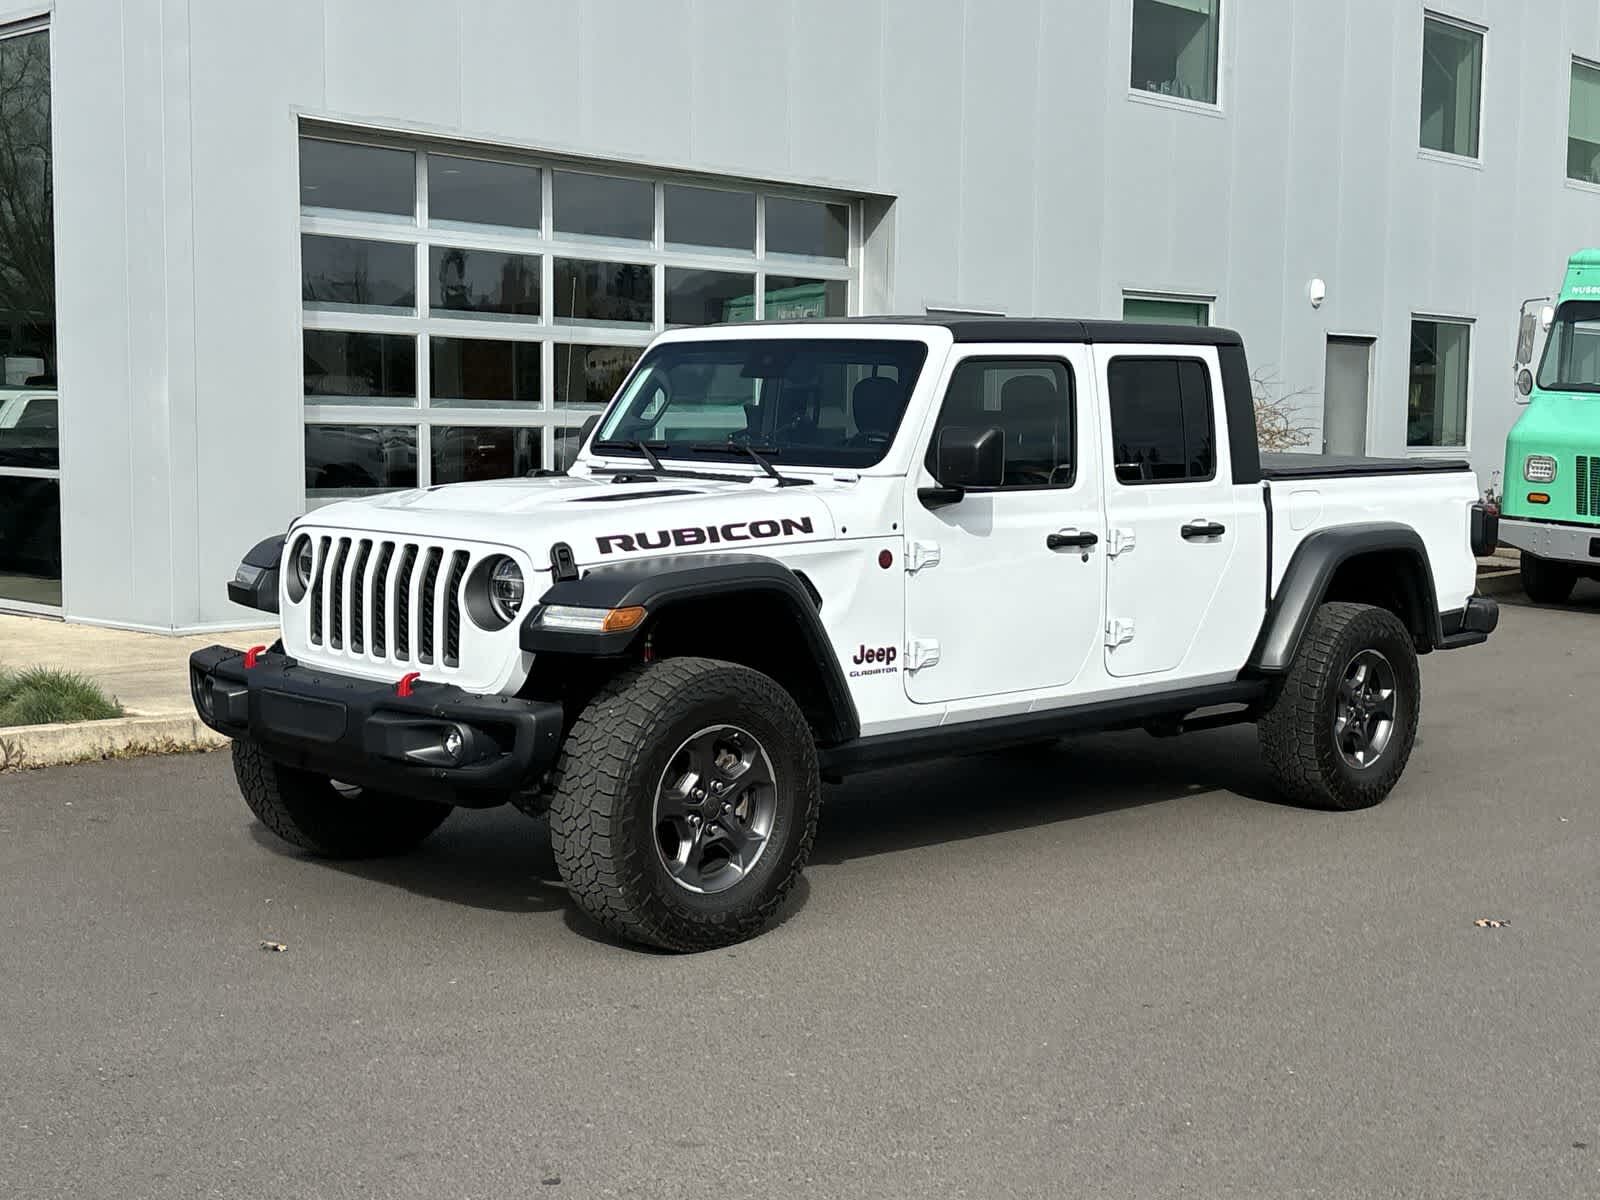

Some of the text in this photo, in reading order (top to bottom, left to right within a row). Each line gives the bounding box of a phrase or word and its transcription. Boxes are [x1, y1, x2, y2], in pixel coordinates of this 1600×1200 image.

[595, 516, 814, 554] RUBICON
[853, 644, 896, 665] Jeep
[849, 667, 897, 677] GLADIATOR
